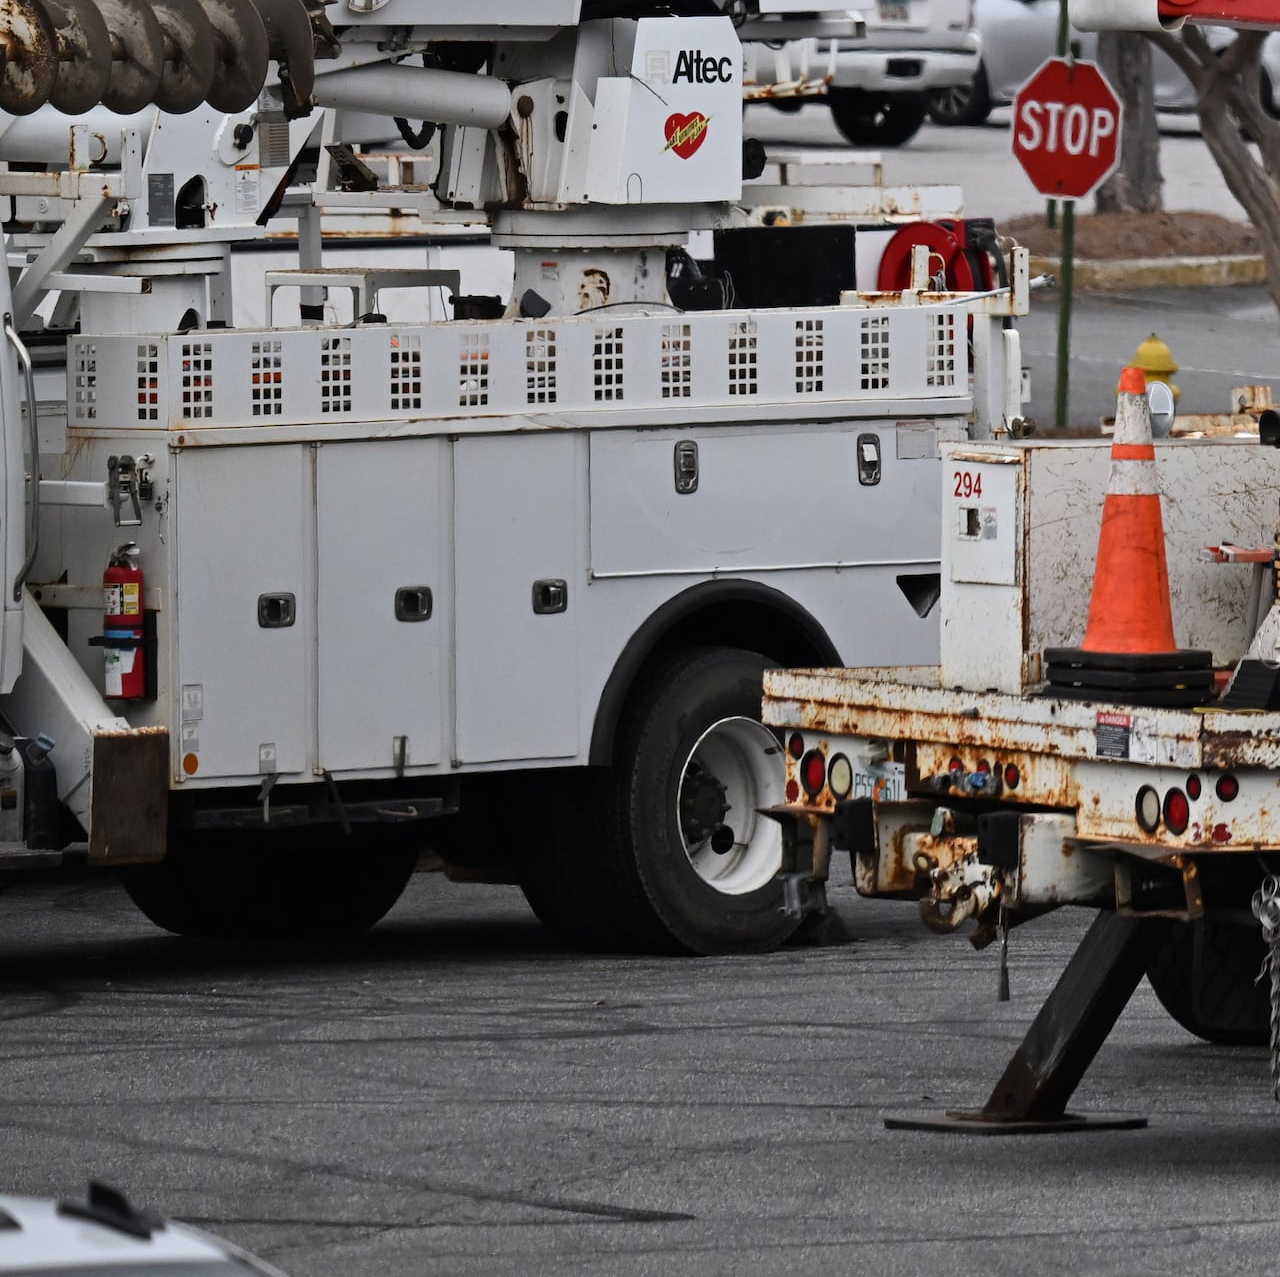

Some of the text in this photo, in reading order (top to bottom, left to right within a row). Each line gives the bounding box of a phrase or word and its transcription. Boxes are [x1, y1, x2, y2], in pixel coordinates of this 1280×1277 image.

[672, 50, 733, 84] Altec
[1018, 99, 1115, 157] STOP
[953, 471, 982, 499] 294
